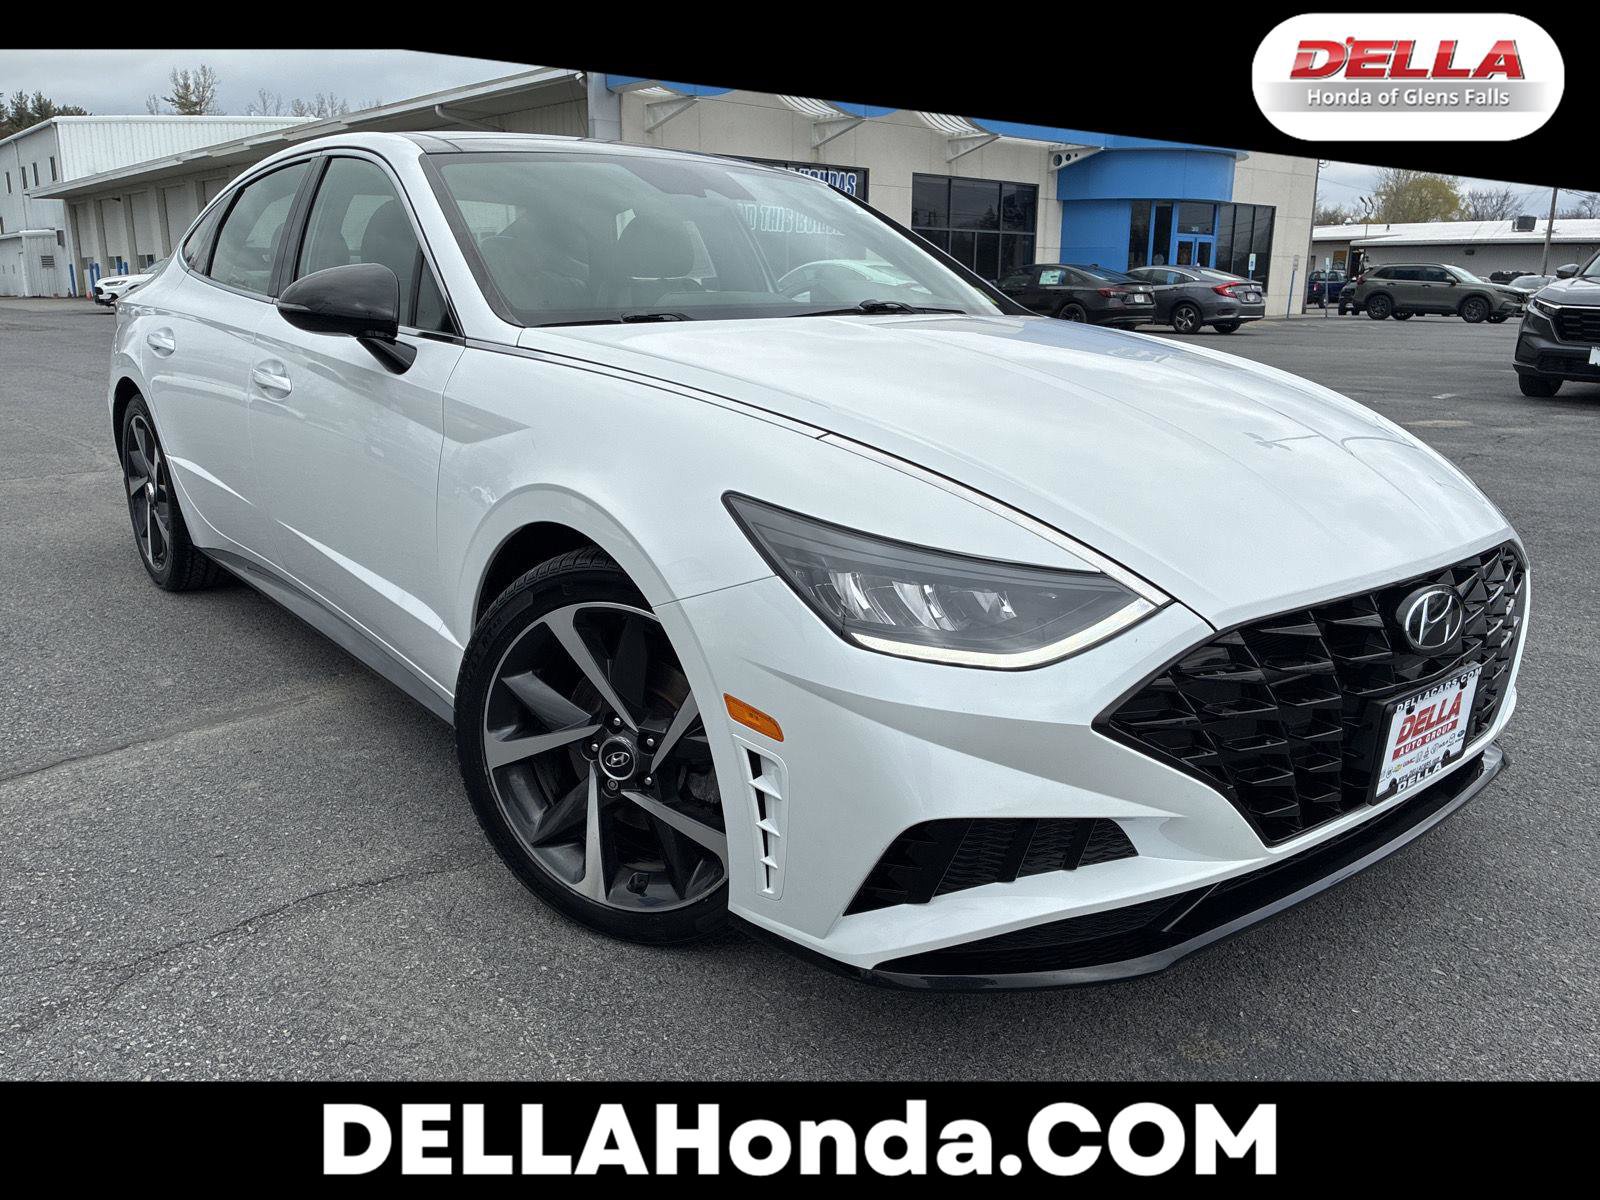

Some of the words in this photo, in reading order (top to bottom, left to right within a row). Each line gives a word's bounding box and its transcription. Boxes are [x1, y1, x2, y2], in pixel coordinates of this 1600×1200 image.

[1399, 737, 1422, 756] AUTO
[1425, 722, 1453, 743] GROUP
[1397, 763, 1442, 791] DELLA
